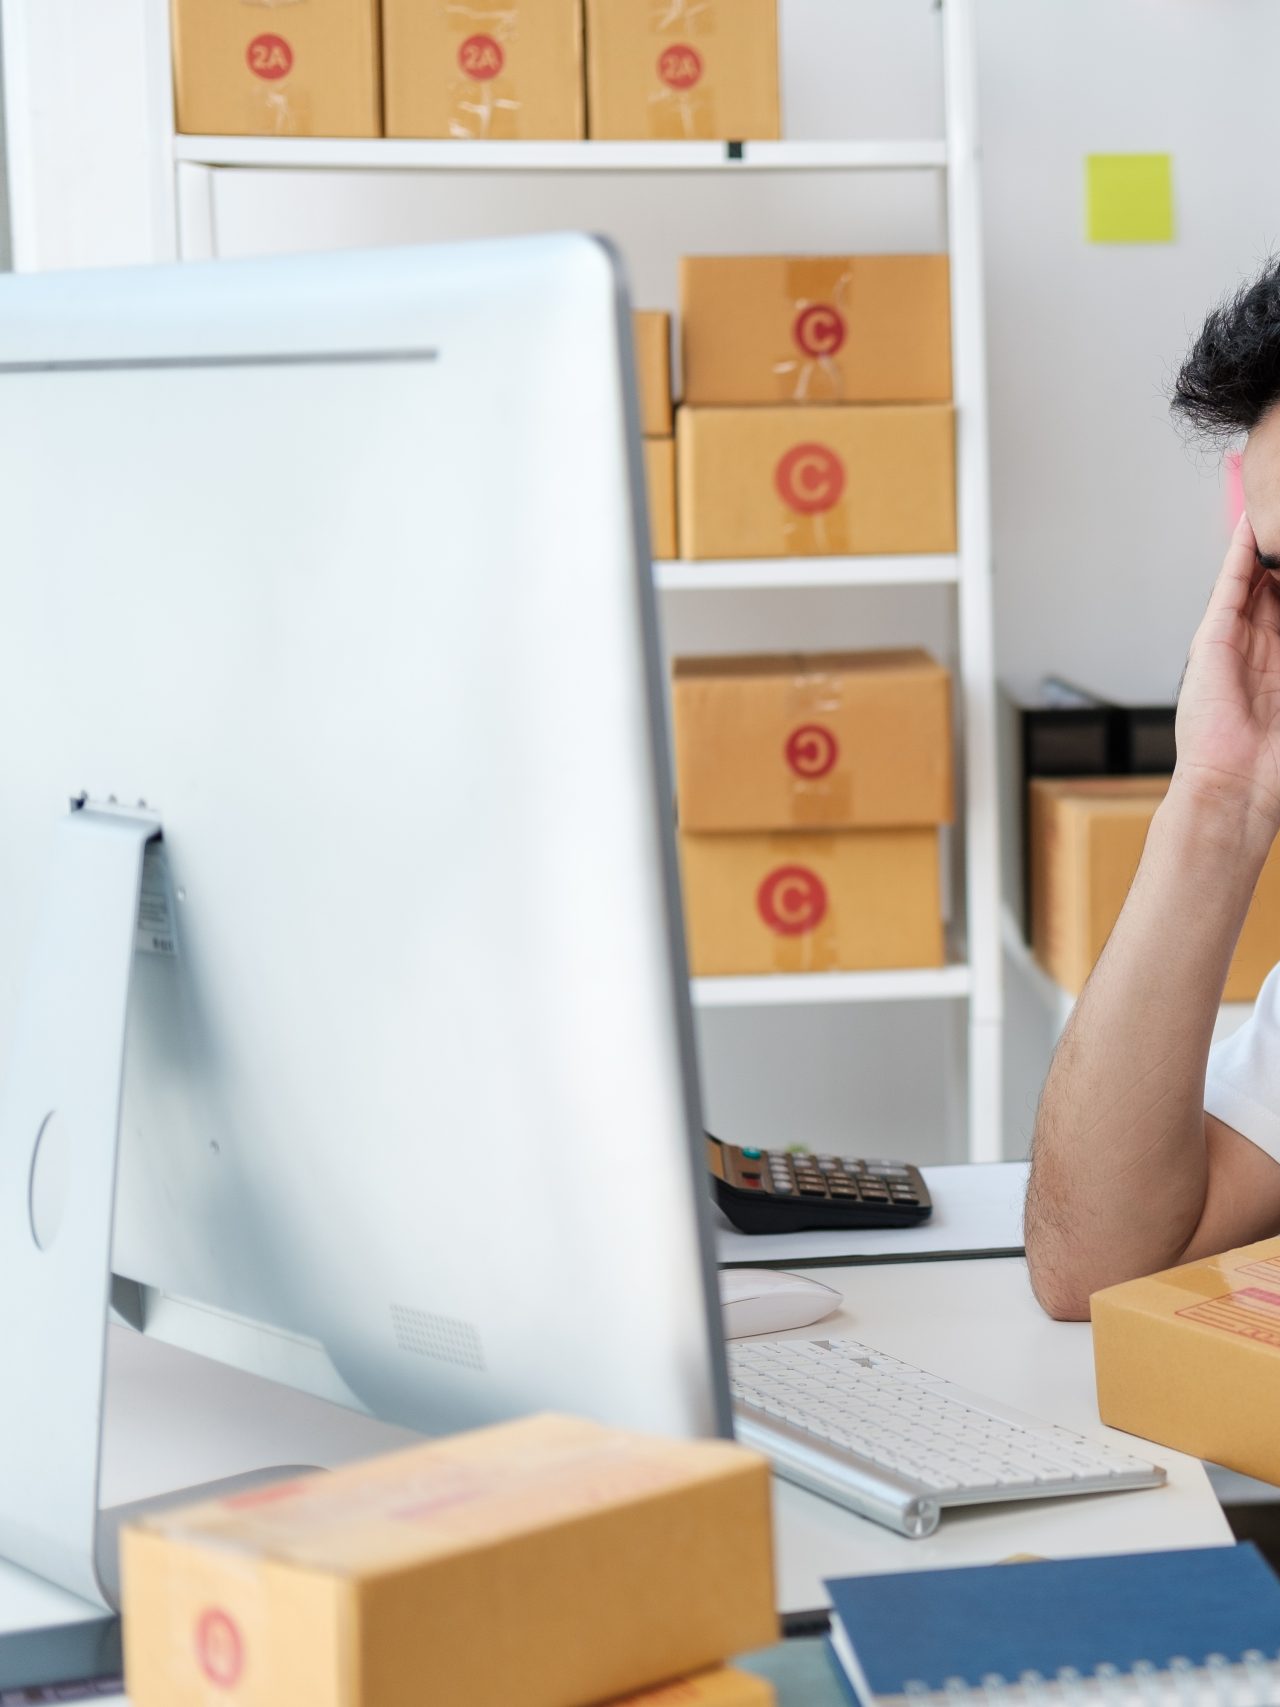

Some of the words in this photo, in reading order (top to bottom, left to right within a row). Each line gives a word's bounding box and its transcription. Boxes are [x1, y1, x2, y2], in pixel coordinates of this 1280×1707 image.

[252, 44, 287, 71] 2A
[463, 44, 498, 71] 2A
[662, 53, 697, 80] 2A
[801, 314, 838, 351] C
[789, 455, 830, 501] C
[793, 732, 830, 772] C
[772, 874, 812, 923] C
